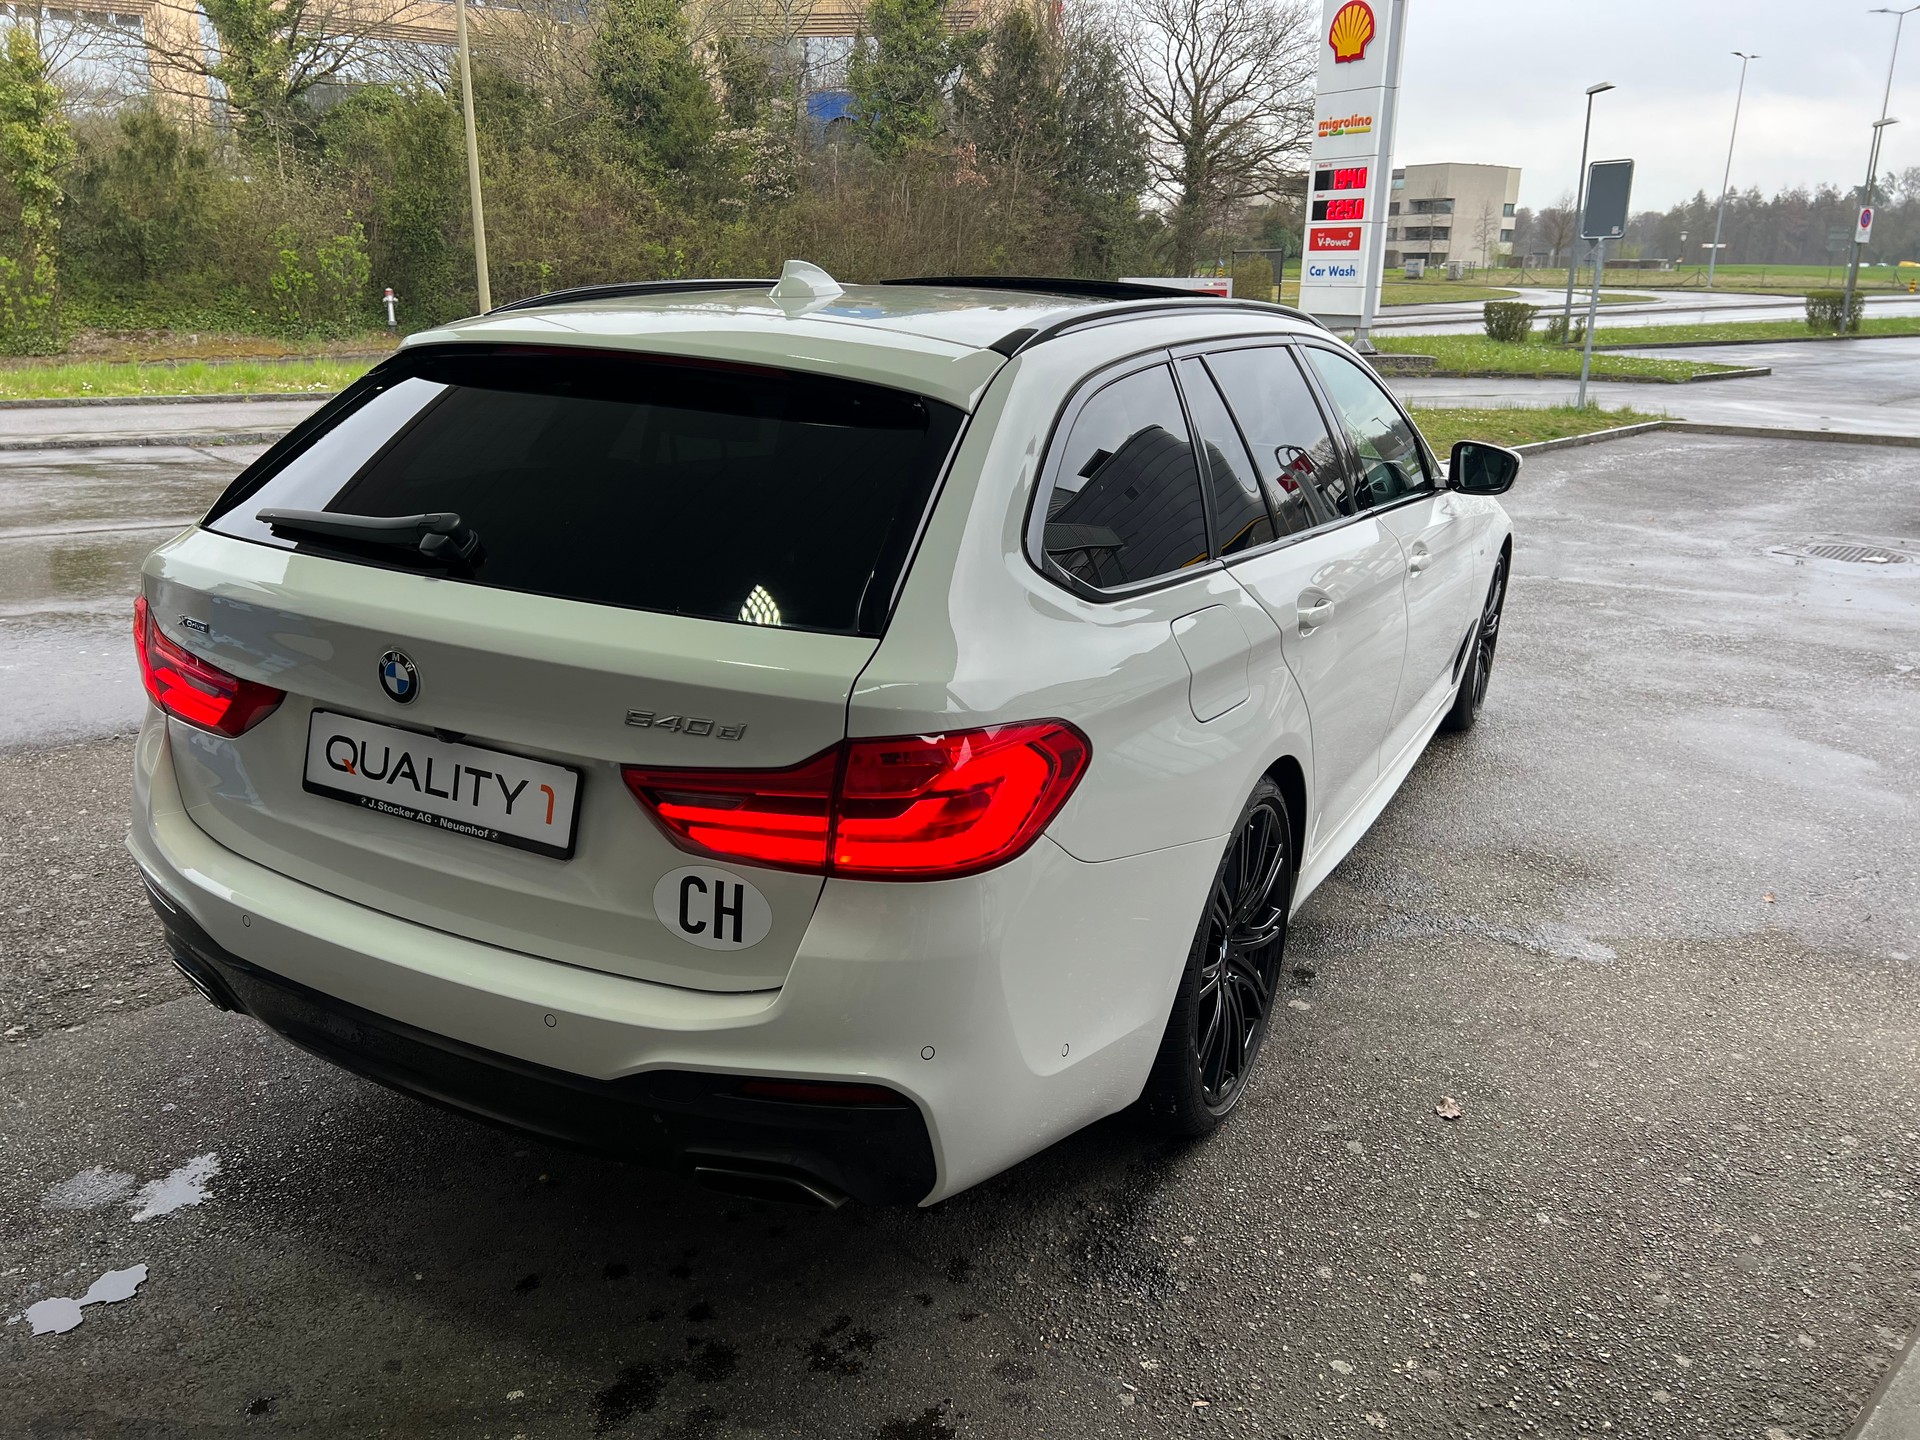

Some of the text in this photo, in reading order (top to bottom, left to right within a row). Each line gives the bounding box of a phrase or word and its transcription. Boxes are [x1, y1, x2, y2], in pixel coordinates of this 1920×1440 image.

[1318, 113, 1372, 132] migrolino
[1317, 237, 1352, 247] V-Power
[1309, 264, 1356, 277] Car Wash
[380, 652, 414, 672] BMW
[325, 734, 555, 825] QUALITY 1
[368, 800, 489, 838] J. Stocker AG Neuenhof
[678, 875, 744, 943] CH
